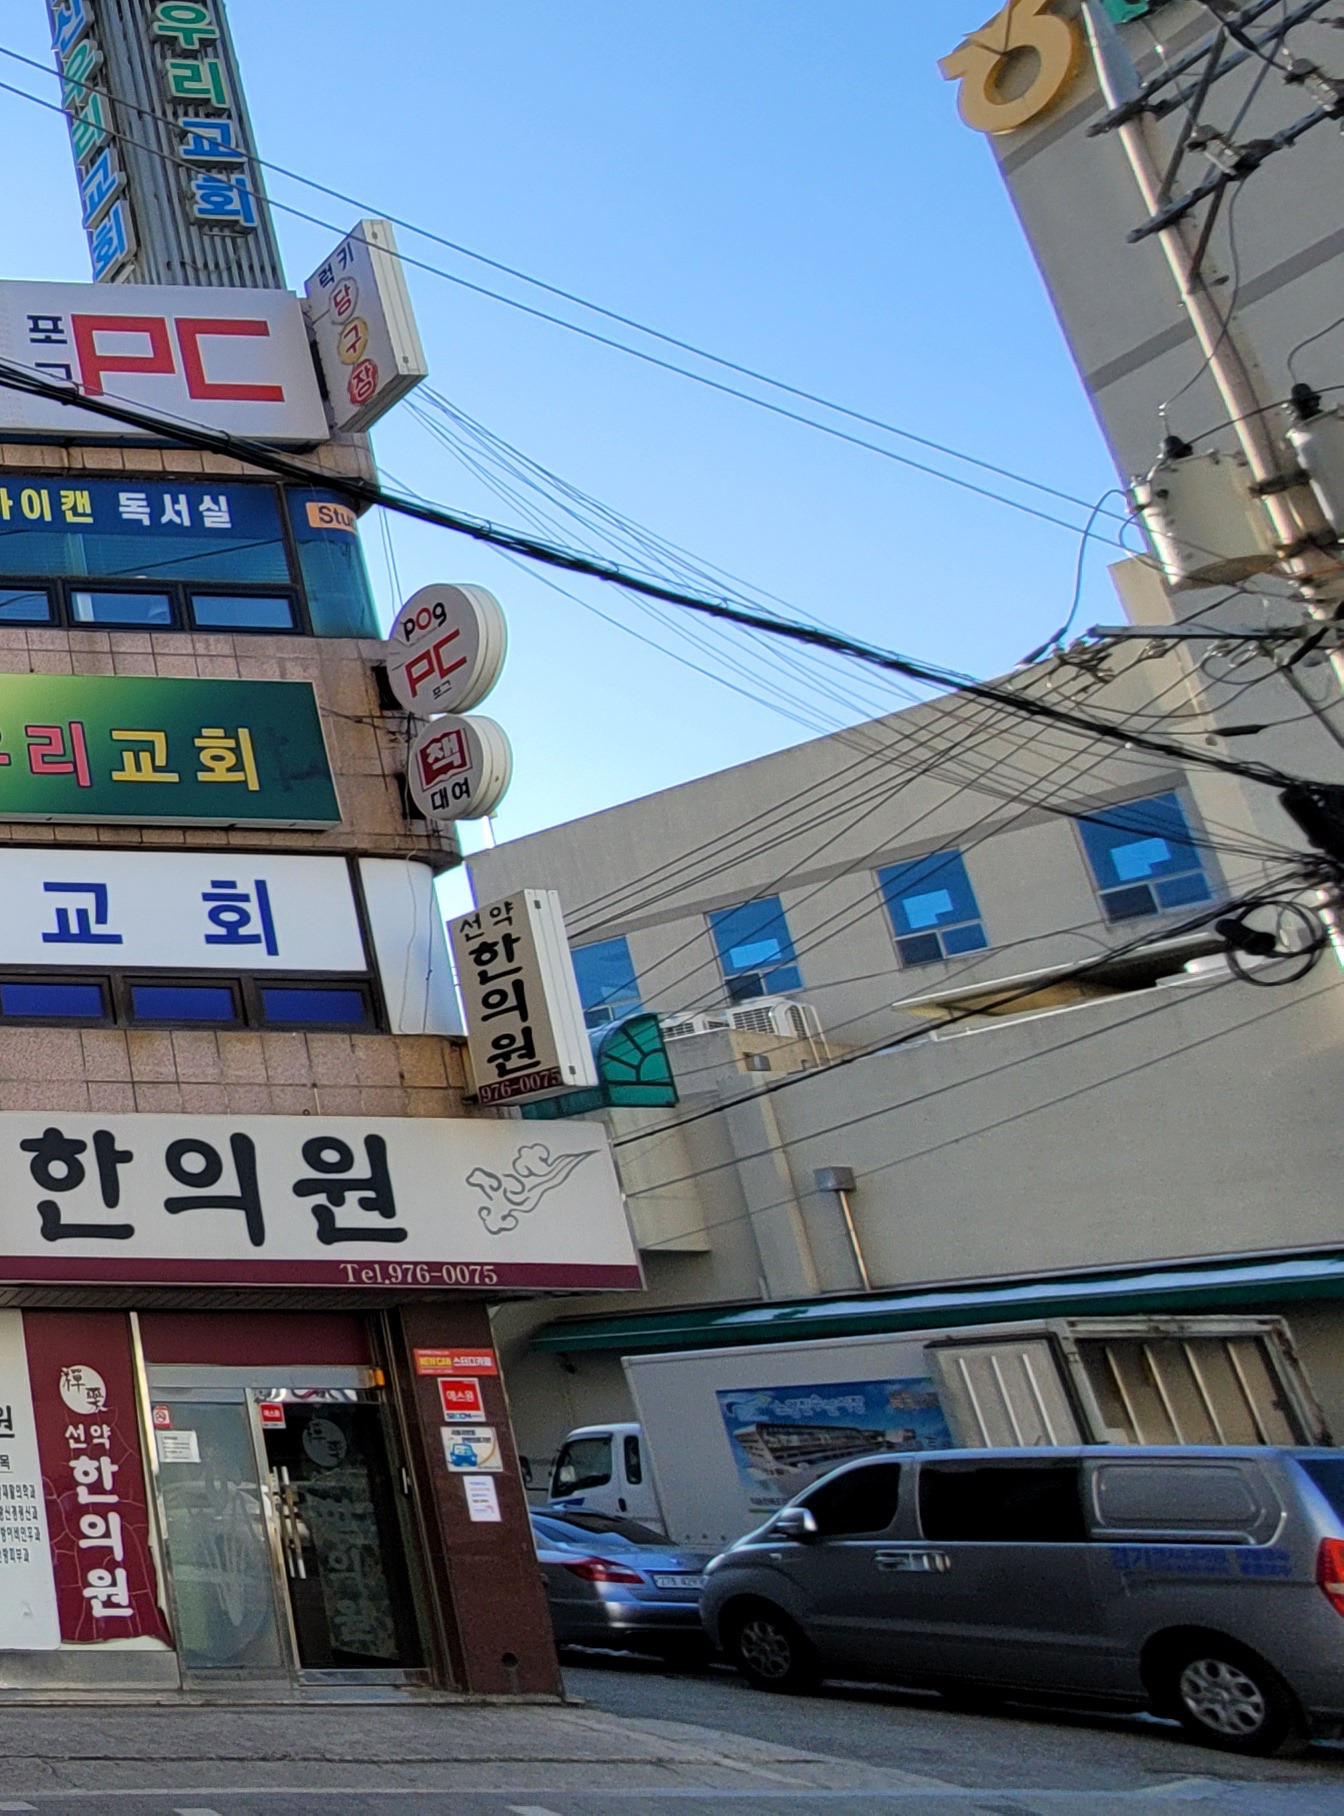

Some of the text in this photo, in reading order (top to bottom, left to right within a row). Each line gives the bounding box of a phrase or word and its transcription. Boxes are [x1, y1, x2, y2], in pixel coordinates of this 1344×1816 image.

[317, 240, 355, 289] 럭키
[70, 313, 286, 404] PC
[332, 283, 374, 402] 당구장
[119, 490, 233, 529] 독서실
[405, 628, 468, 699] PC
[425, 733, 462, 772] 책
[430, 776, 472, 812] 대여
[459, 900, 515, 943] 선약
[468, 932, 542, 1079] 한의원
[480, 1069, 562, 1104] 976-0075
[19, 1126, 410, 1247] 한의원
[64, 1423, 112, 1450] 선약
[68, 1456, 135, 1618] 한의원
